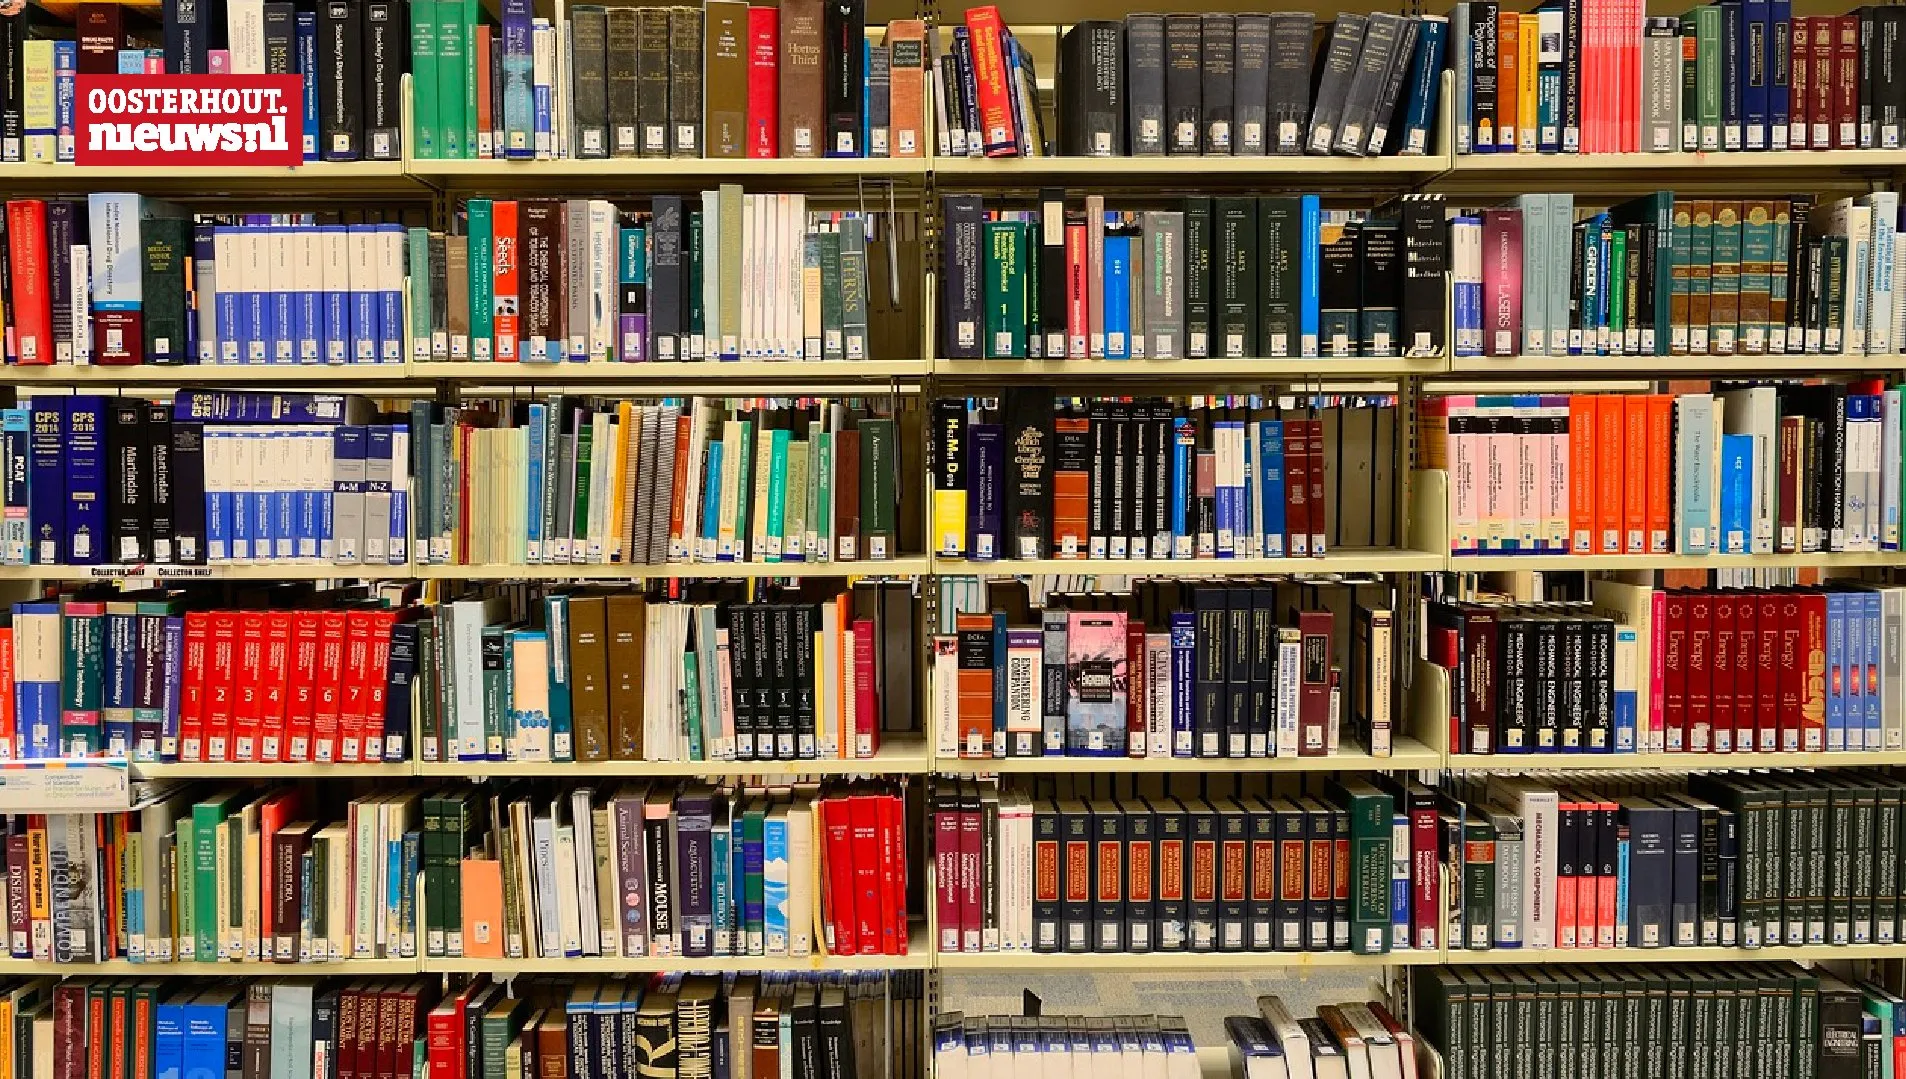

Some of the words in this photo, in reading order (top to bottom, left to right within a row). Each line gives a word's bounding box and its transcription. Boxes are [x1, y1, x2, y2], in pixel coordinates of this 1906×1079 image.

[1486, 6, 1496, 56] Properties
[1568, 0, 1576, 40] GLOSSARY
[334, 24, 344, 58] Stockley's
[374, 27, 384, 62] Stockley's
[788, 44, 820, 54] Hortus
[1474, 22, 1484, 69] Polymers
[335, 62, 344, 80] Drug
[376, 64, 384, 82] Drug
[791, 55, 818, 65] Third
[978, 44, 988, 80] Format
[984, 26, 995, 66] Scientific
[990, 68, 999, 96] Style
[1487, 58, 1496, 69] of
[1568, 60, 1576, 94] MAPPING
[24, 206, 34, 256] Dictionary
[105, 203, 114, 244] International
[105, 246, 114, 264] Drug
[498, 238, 510, 274] Seeds
[540, 236, 548, 250] THE
[1154, 232, 1163, 253] Desk
[26, 268, 36, 294] Drugs
[105, 265, 114, 294] Directory
[540, 251, 548, 282] CHEMICAL
[1154, 254, 1163, 295] Reference
[1587, 246, 1596, 295] GREEN
[844, 256, 858, 312] FERNS
[540, 284, 548, 326] COMPONENTS
[1499, 284, 1510, 328] LASERS
[35, 412, 60, 422] CPS
[72, 412, 95, 422] CPS
[192, 394, 202, 416] CPS
[203, 394, 212, 416] 2015
[1836, 398, 1844, 430] MODERN
[36, 424, 60, 433] 2014
[946, 418, 958, 460] HazMat
[15, 456, 24, 482] PCAT
[127, 446, 138, 504] Martindale
[157, 444, 168, 504] Martindale
[946, 462, 958, 486] Data
[1835, 432, 1843, 491] CONSTRUCTION
[338, 482, 358, 491] A-M
[370, 482, 387, 491] N-Z
[158, 568, 193, 576] COLLECTOR
[1516, 633, 1524, 676] MECHANICAL
[1667, 630, 1684, 670] Energy
[1691, 631, 1710, 670] Energy
[1716, 631, 1732, 670] Energy
[1737, 630, 1754, 670] Energy
[1759, 630, 1776, 670] Energy
[1782, 630, 1799, 670] Energy
[76, 669, 84, 708] Technology
[113, 668, 122, 705] Technology
[144, 668, 153, 705] Technology
[190, 690, 197, 702] 1
[216, 690, 225, 702] 2
[244, 690, 253, 702] 3
[268, 690, 279, 702] 4
[299, 690, 308, 702] 5
[324, 690, 332, 702] 6
[350, 689, 358, 700] 7
[374, 690, 382, 702] 8
[1011, 658, 1020, 711] COMPANION
[1021, 658, 1030, 721] ENGINEERING
[1802, 650, 1824, 723] energy
[620, 808, 630, 840] Animal
[32, 834, 42, 864] Nursing
[540, 840, 550, 867] Pines
[622, 840, 630, 872] Science
[34, 867, 43, 908] Programs
[688, 840, 698, 906] AQUACULTURE
[1362, 854, 1370, 907] MATERIALS
[10, 866, 22, 924] DISEASES
[655, 883, 667, 930] MOUSE
[1378, 902, 1386, 916] OF
